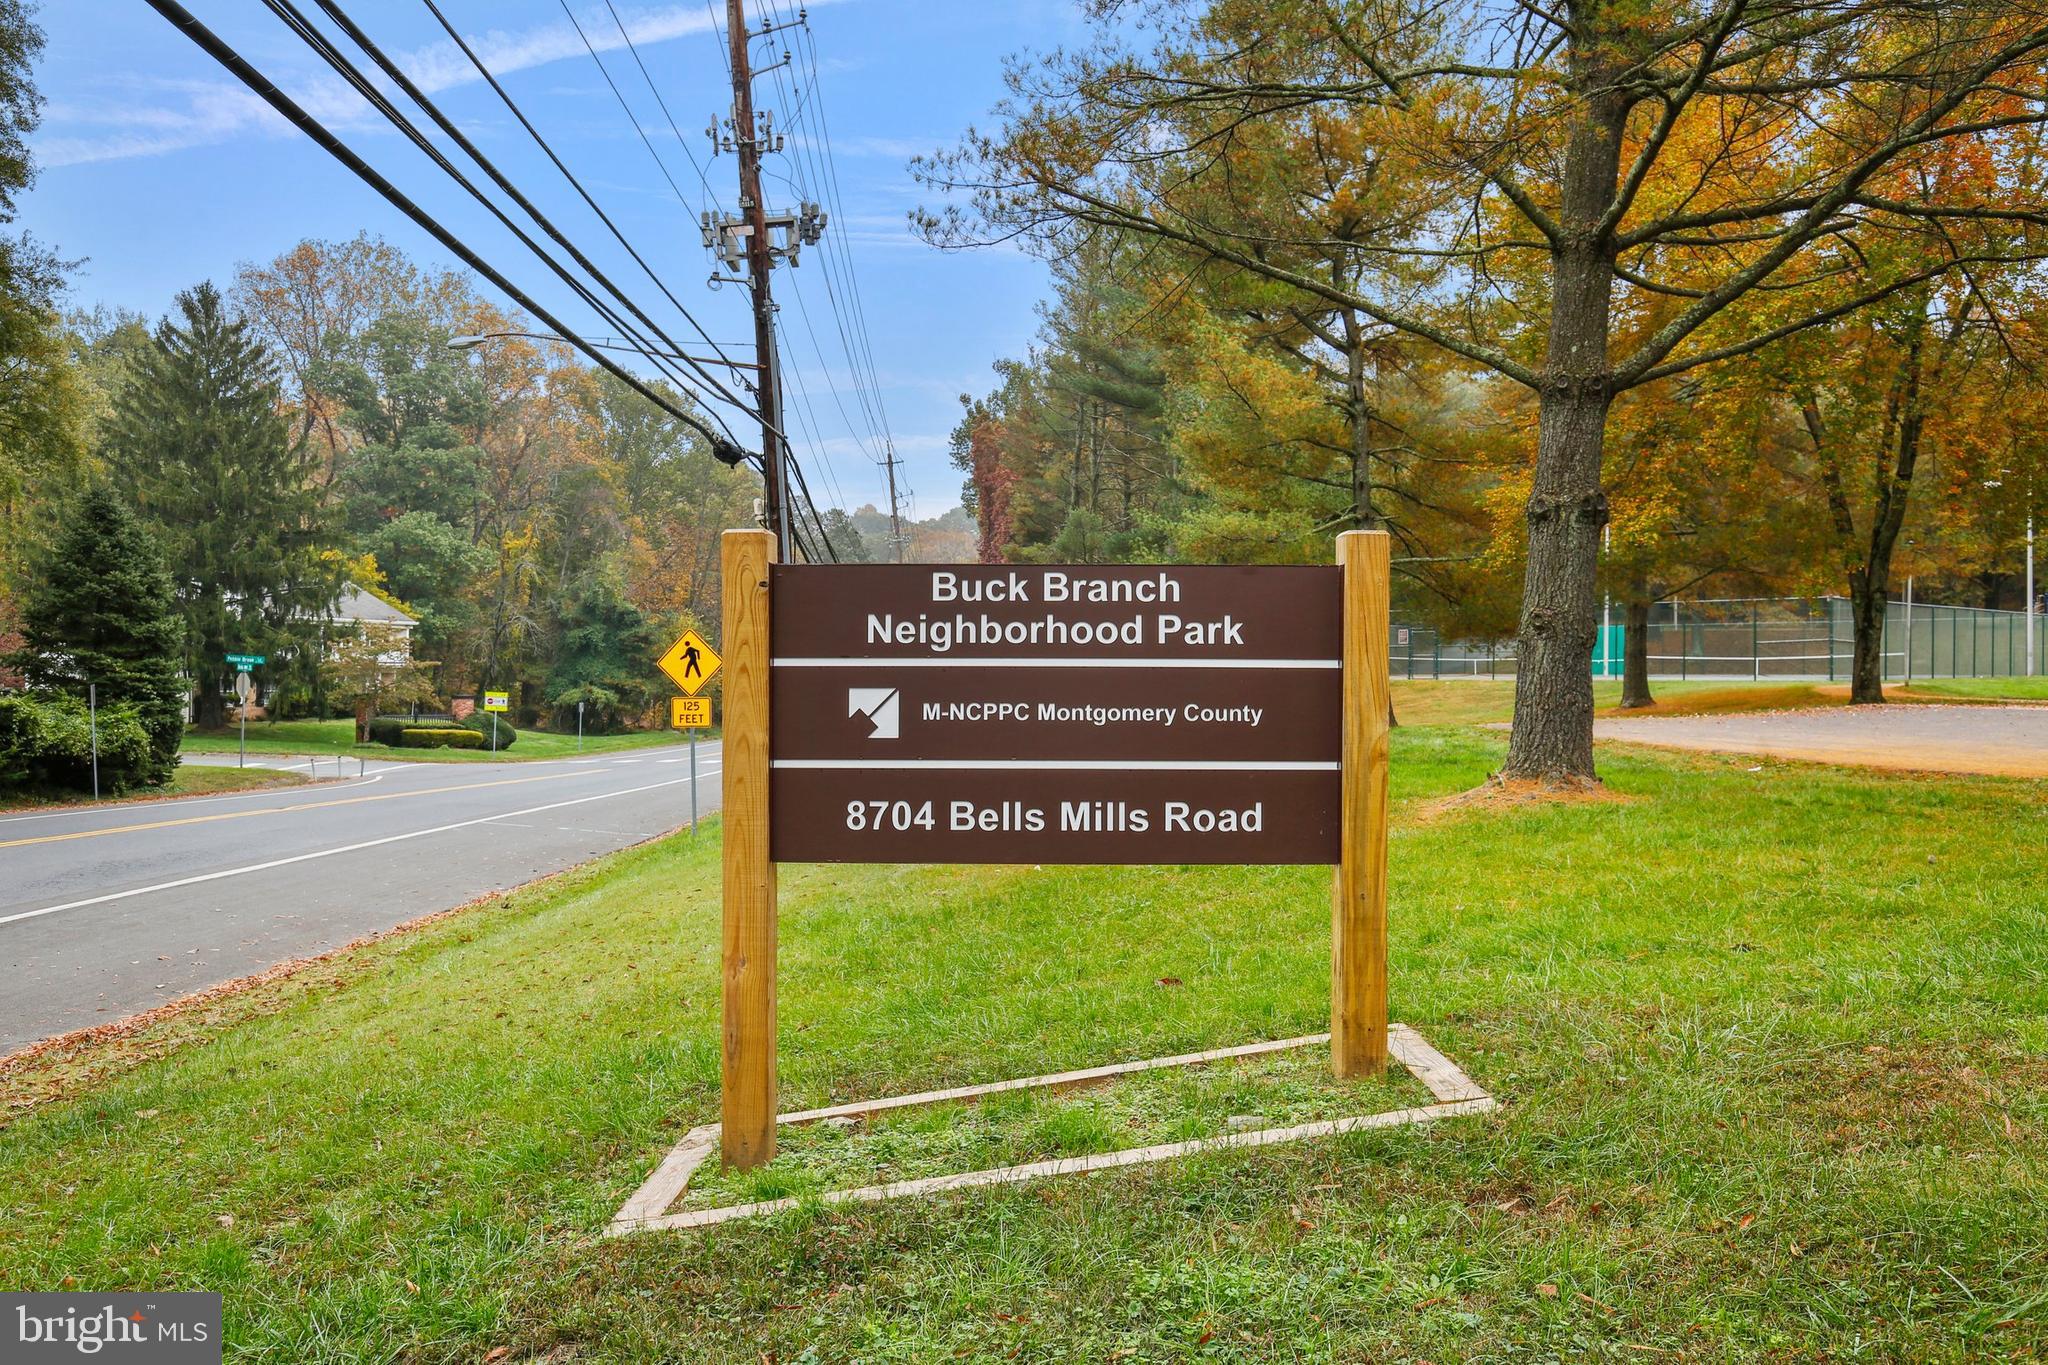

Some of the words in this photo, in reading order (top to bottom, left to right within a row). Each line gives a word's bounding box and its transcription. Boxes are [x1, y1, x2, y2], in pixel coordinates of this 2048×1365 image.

[931, 571, 1030, 603] Buck
[1043, 572, 1181, 603] Branch
[866, 613, 1143, 652] Neighborhood
[1157, 614, 1245, 646] Park
[679, 714, 704, 724] FEET
[683, 701, 700, 711] 125
[922, 702, 1030, 722] M-NCPPC
[1037, 703, 1177, 727] Montgomery
[1183, 703, 1264, 727] County
[846, 800, 936, 832] 8704
[949, 801, 1046, 832] Bells
[1059, 802, 1150, 832] Mills
[1163, 802, 1263, 832] Road
